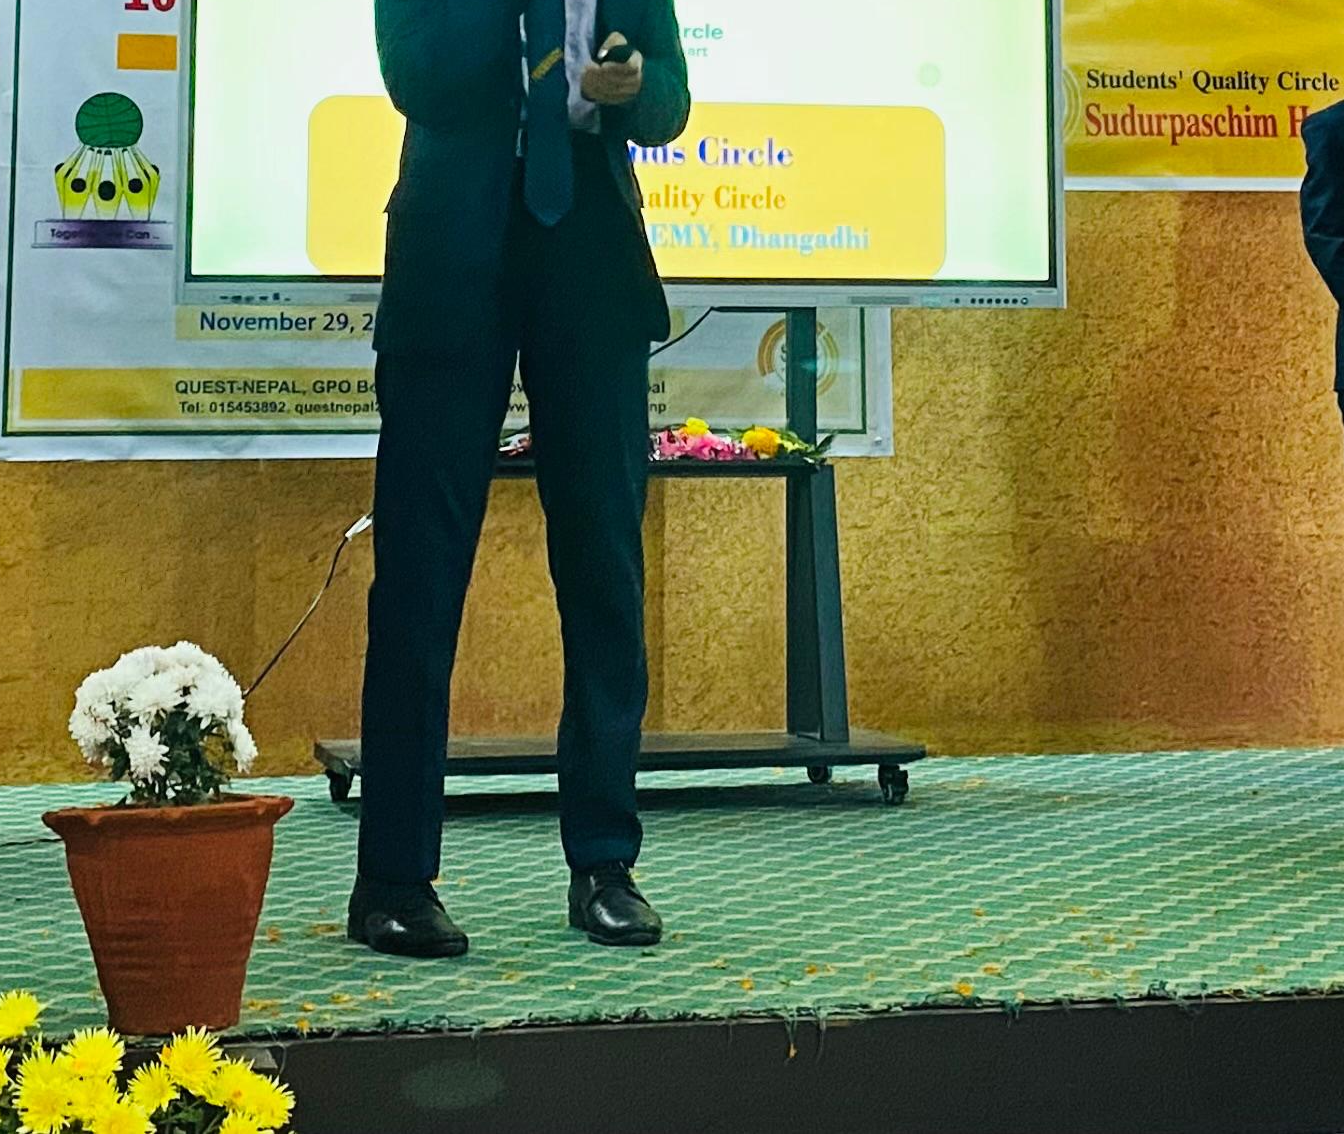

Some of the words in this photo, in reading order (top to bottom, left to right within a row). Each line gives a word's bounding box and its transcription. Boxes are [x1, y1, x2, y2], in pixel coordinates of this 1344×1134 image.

[683, 23, 724, 40] rcle
[1086, 69, 1183, 91] Students'
[1192, 70, 1270, 95] Quality
[1277, 70, 1340, 92] Circle
[1084, 102, 1278, 147] Sudurpaschim
[698, 135, 794, 167] Circle
[647, 183, 705, 216] ality
[714, 184, 787, 210] Circle
[649, 223, 720, 252] EMY,
[729, 224, 870, 256] Dhangadhi
[200, 311, 316, 332] November
[322, 312, 355, 334] 29,
[175, 379, 307, 396] QUEST-NEPAL,
[312, 379, 351, 395] GPO
[179, 400, 205, 414] Tel:
